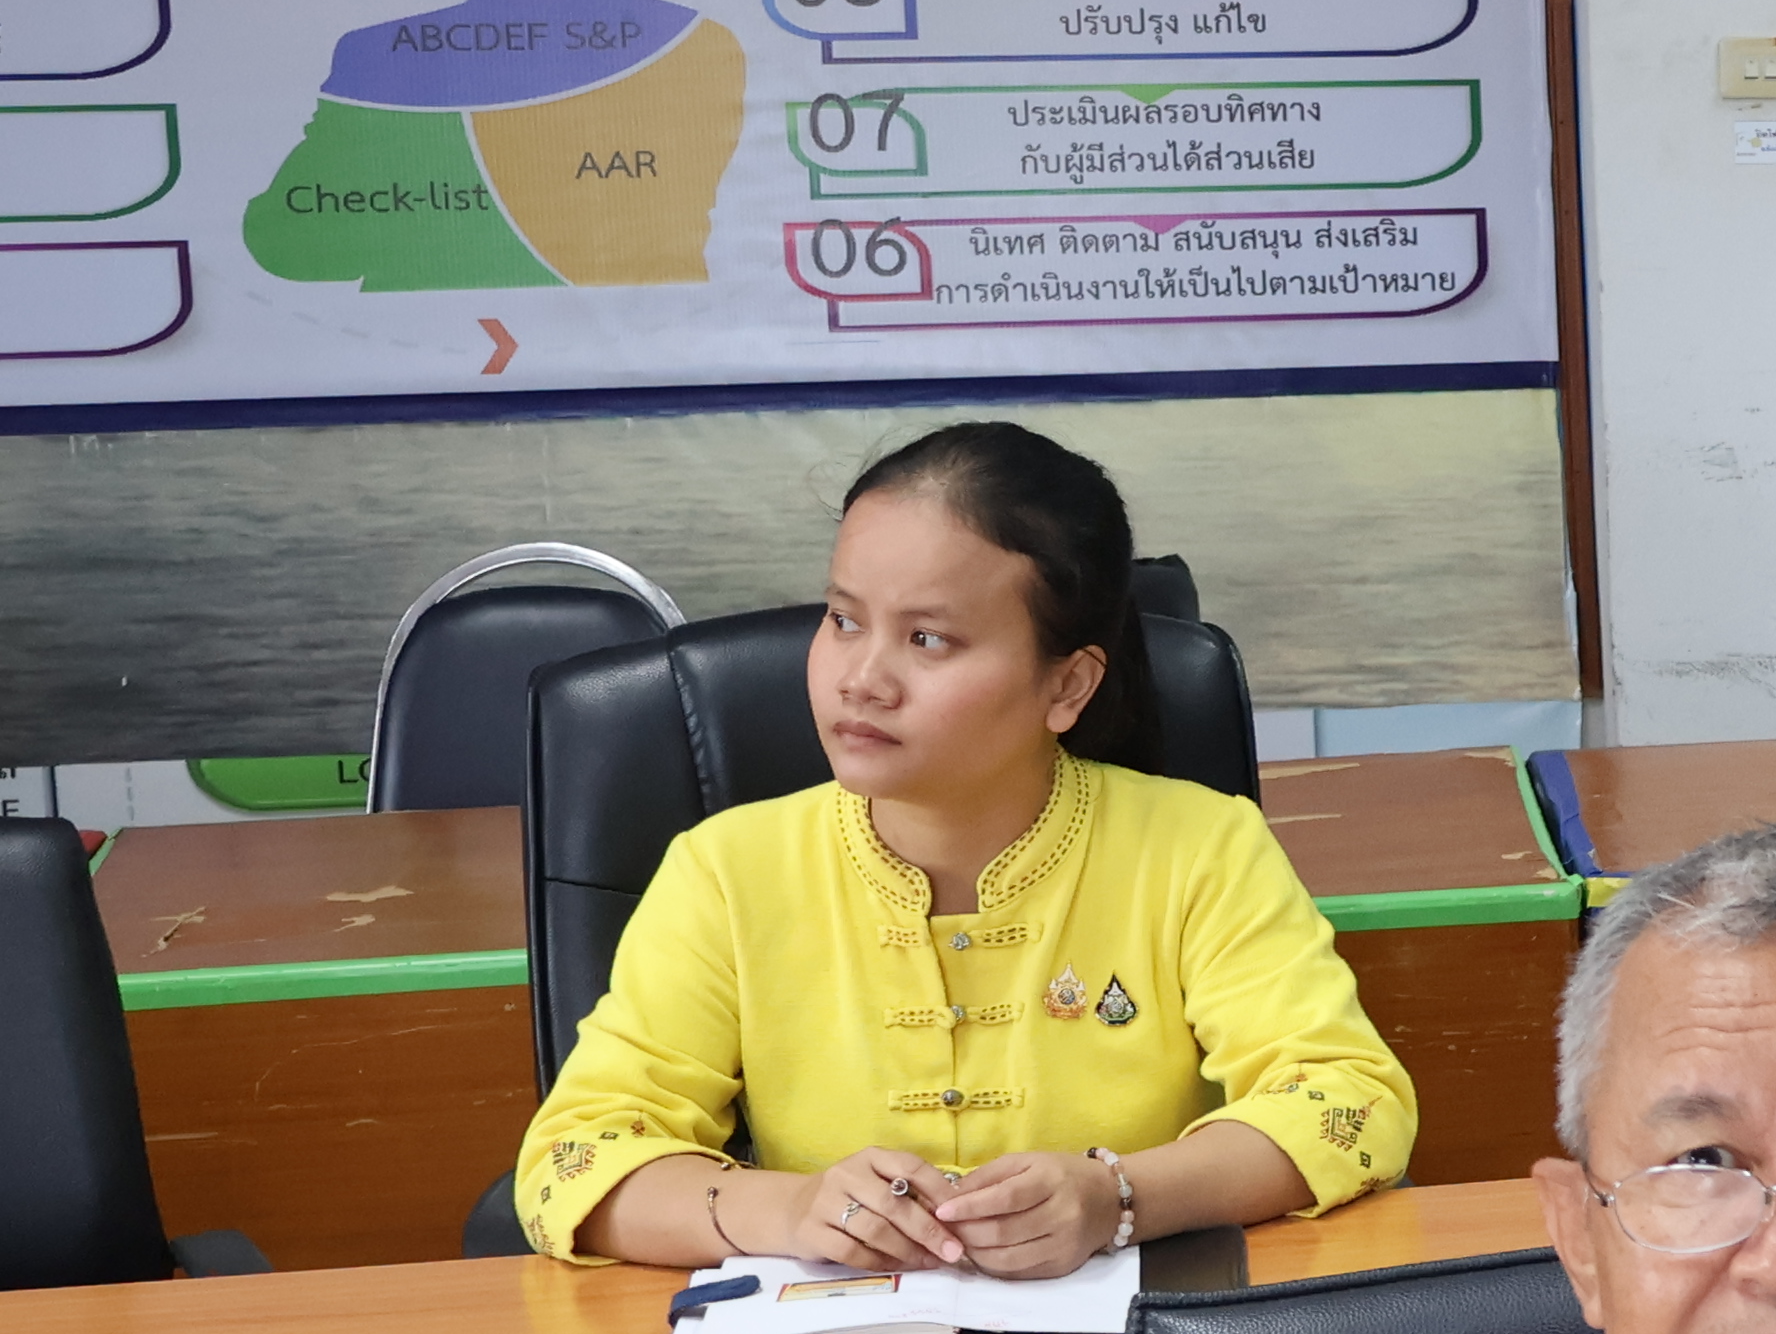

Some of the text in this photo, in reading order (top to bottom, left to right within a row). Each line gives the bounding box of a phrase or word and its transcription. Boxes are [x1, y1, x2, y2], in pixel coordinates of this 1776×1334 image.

[392, 21, 642, 52] ABCDEF S&P
[1059, 3, 1267, 38] ปรับปรุง แก้ไข
[811, 92, 904, 153] 07
[1007, 96, 1321, 128] ประเมินผลรอบทิศทาง
[575, 150, 658, 179] AAR
[1020, 140, 1316, 184] กับผู้มีส่วนได้ส่วนเสีย
[286, 182, 489, 215] Check-list
[811, 216, 908, 278] 06
[969, 220, 1419, 260] นิเทศ ติดตาม สนับสนุน ส่งเสริม
[935, 264, 1456, 306] การดำเนินงานให้เป็นไปตามเป้าหมาย
